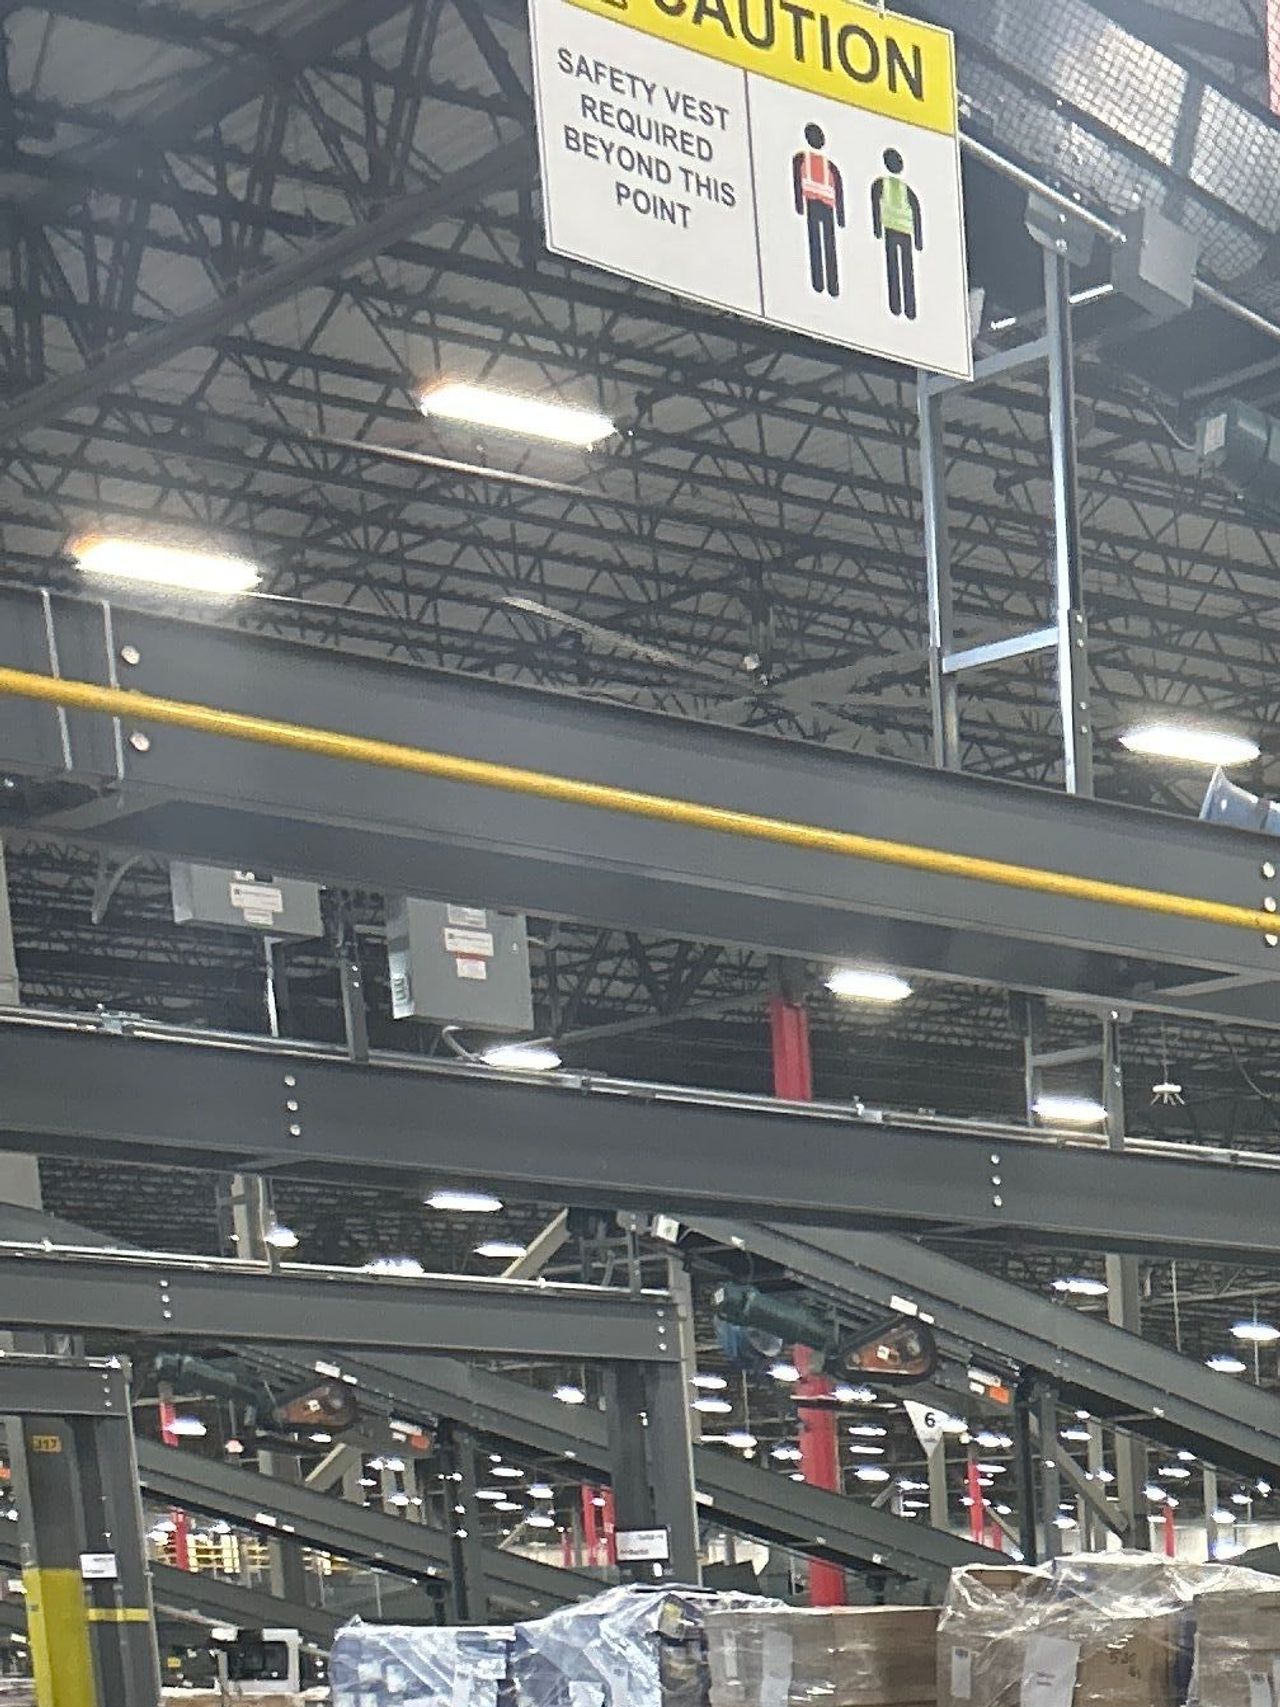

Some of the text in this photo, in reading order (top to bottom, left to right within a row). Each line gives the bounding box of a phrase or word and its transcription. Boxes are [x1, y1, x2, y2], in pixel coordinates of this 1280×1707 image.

[557, 47, 730, 131] SAFETY VEST
[650, 0, 925, 102] AUTION
[565, 125, 736, 207] BEYOND THIS
[580, 94, 713, 163] REQUIRED
[615, 181, 692, 229] POINT
